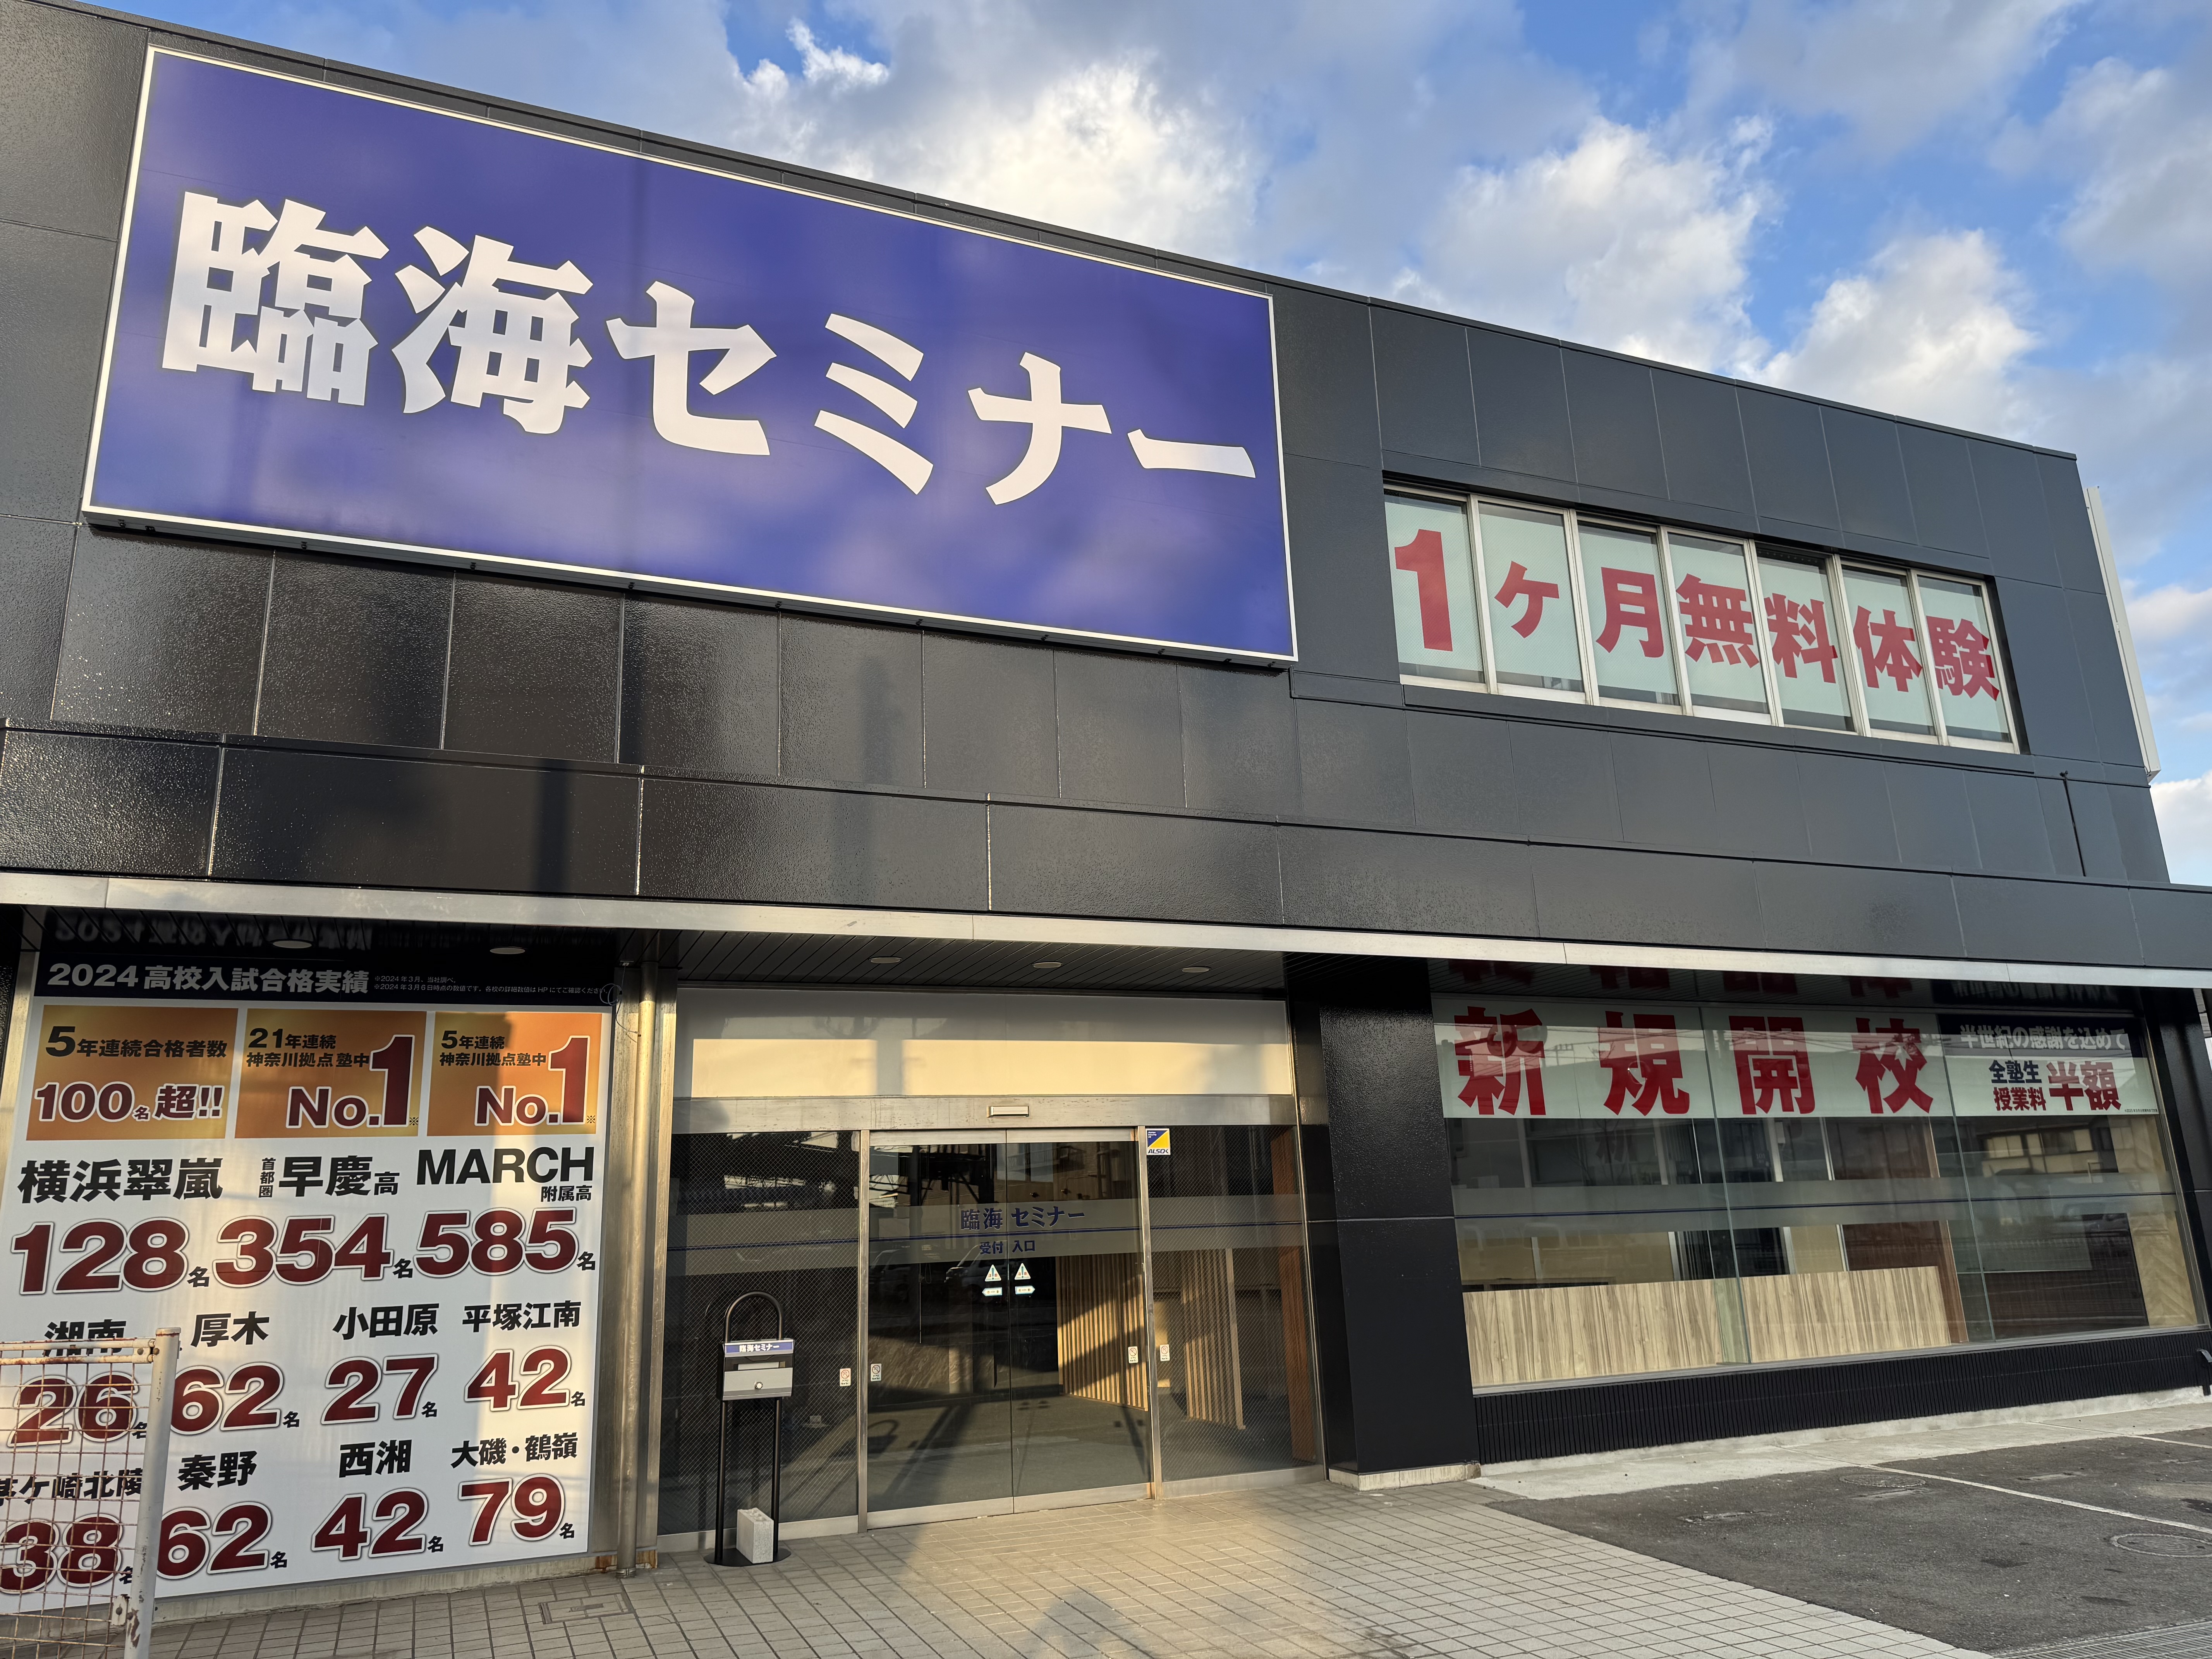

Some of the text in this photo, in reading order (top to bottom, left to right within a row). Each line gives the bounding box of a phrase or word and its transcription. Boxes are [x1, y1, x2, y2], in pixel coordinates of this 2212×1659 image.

[161, 189, 1257, 505] 臨海セミナー
[47, 963, 369, 994] 2024高校入試合格実績
[45, 1026, 227, 1058] 5年連続合格者数
[248, 1028, 336, 1049] 21年連続
[441, 1030, 505, 1050] 5年連続
[1960, 1024, 2126, 1050] 半世紀の感謝を込めて
[246, 1052, 369, 1068] 神奈川拠点塾中
[440, 1052, 547, 1066] 神奈川拠点塾中
[1454, 1006, 1934, 1116] 新規開校
[1989, 1060, 2042, 1084] 全塾生
[1993, 1087, 2047, 1111] 授業料
[2046, 1061, 2121, 1111] 半額
[17, 1158, 223, 1204] 横浜翠嵐
[416, 1147, 594, 1185] MARCH
[541, 1185, 593, 1202] 附属高
[11, 1217, 210, 1295] 128名
[213, 1214, 413, 1288] 354名
[414, 1207, 596, 1278] 585名
[191, 1311, 270, 1347] 厚木
[333, 1303, 439, 1340] 小田原
[462, 1300, 581, 1333] 平塚江南
[321, 1353, 437, 1425] 27名
[464, 1345, 586, 1412] 42名
[339, 1439, 412, 1478] 西湘
[451, 1432, 578, 1468] 大磯・鶴嶺
[178, 1451, 257, 1491] 秦野
[311, 1488, 444, 1561] 42名
[458, 1473, 575, 1546] 79名
